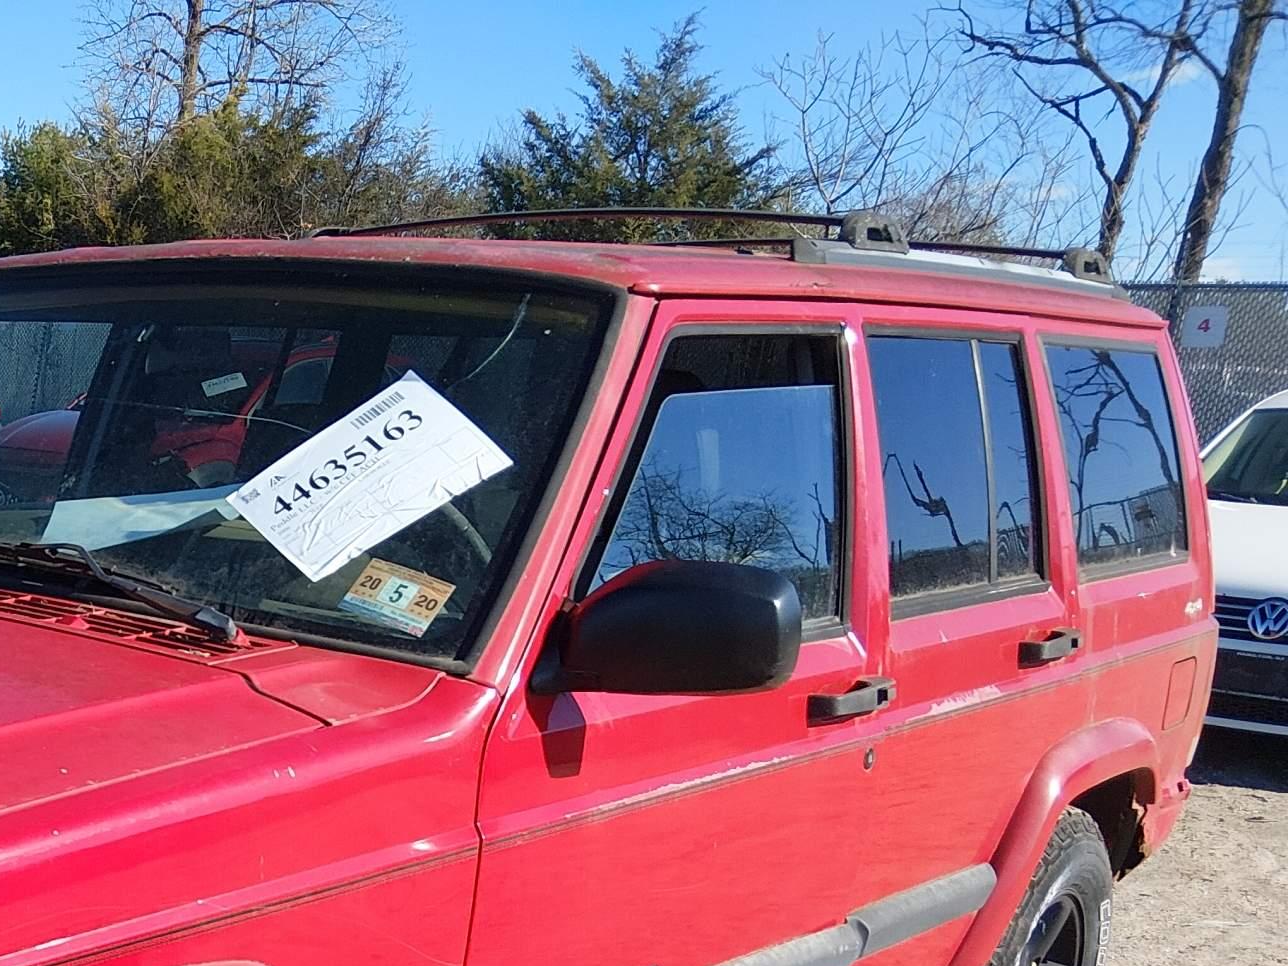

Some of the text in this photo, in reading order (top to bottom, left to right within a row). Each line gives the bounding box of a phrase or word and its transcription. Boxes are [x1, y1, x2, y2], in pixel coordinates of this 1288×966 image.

[1197, 318, 1210, 333] 4
[273, 408, 424, 516] 44635163
[359, 575, 383, 591] 20
[388, 583, 409, 604] 5
[413, 594, 439, 612] 20
